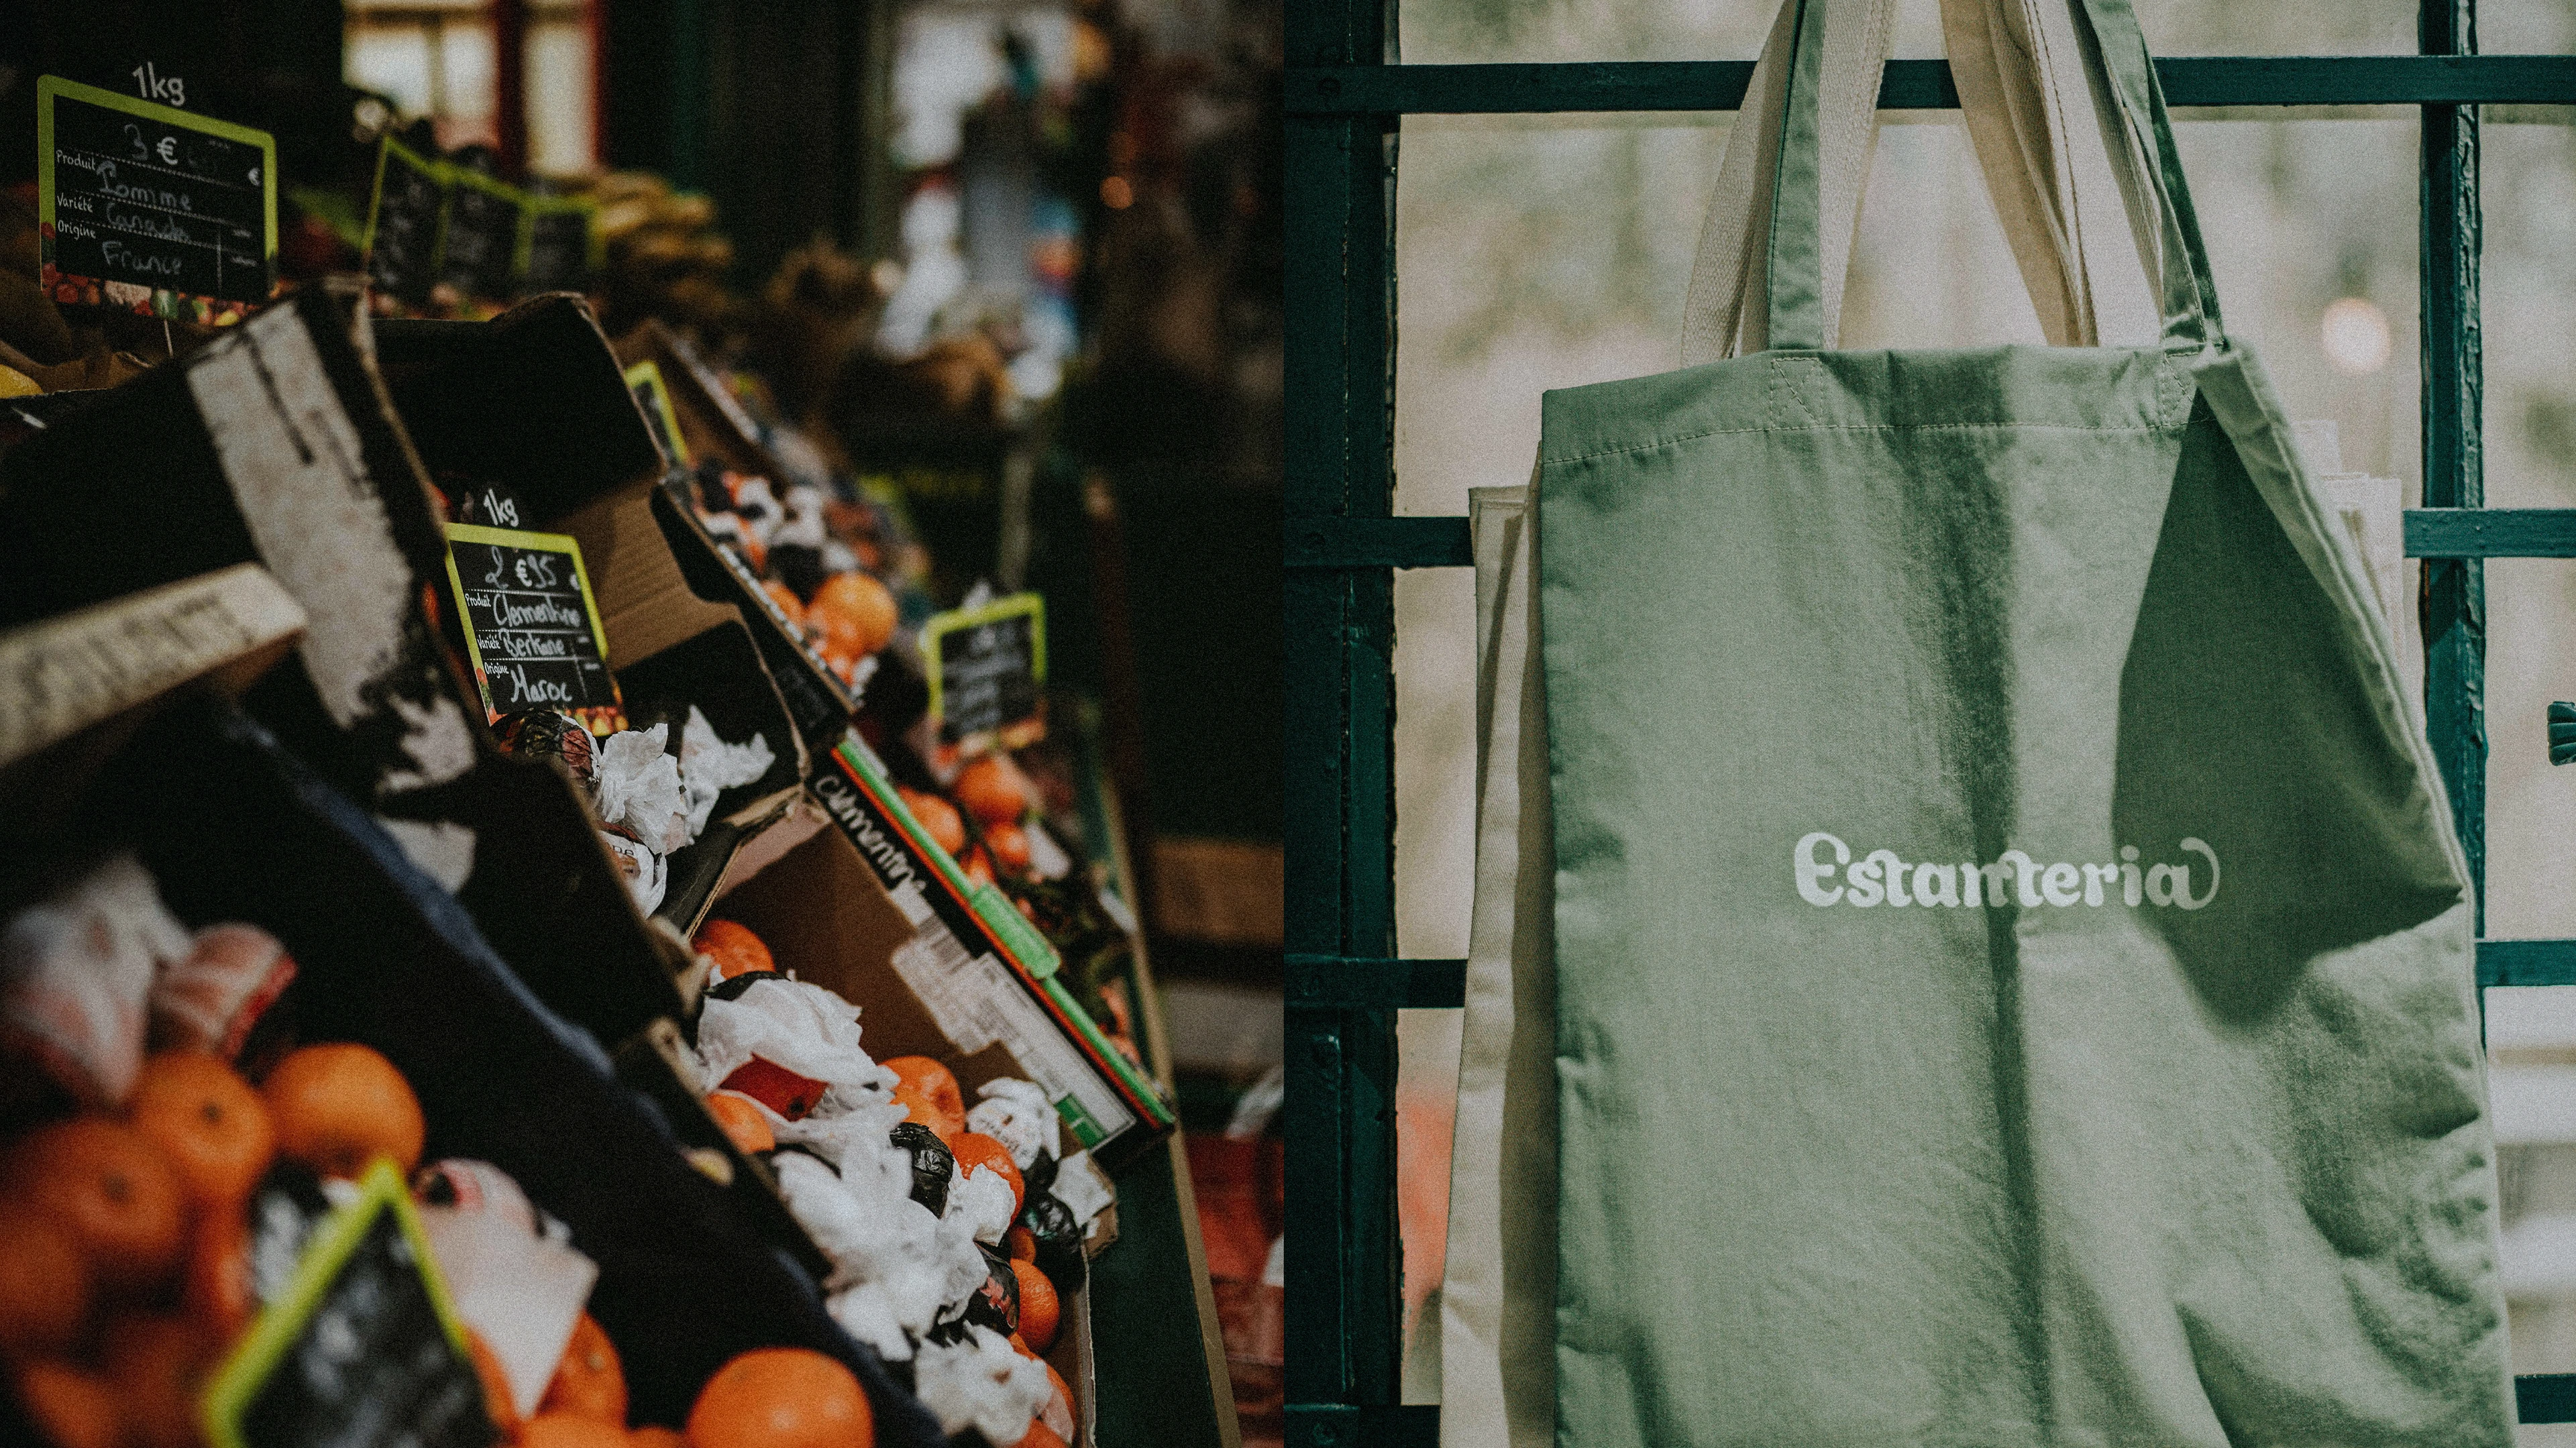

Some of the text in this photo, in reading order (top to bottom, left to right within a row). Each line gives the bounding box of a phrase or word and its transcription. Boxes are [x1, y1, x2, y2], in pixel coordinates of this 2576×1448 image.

[132, 61, 186, 107] 1kg
[56, 150, 97, 171] Produit
[157, 136, 178, 165] €
[57, 194, 93, 213] Variété
[58, 219, 97, 240] Origine
[102, 240, 182, 275] France
[483, 488, 519, 528] 1kg
[464, 592, 492, 608] Produit
[476, 634, 500, 651] Variété
[484, 661, 509, 679] Origine
[510, 663, 572, 704] Maroc
[1794, 831, 2220, 911] Estanteria
